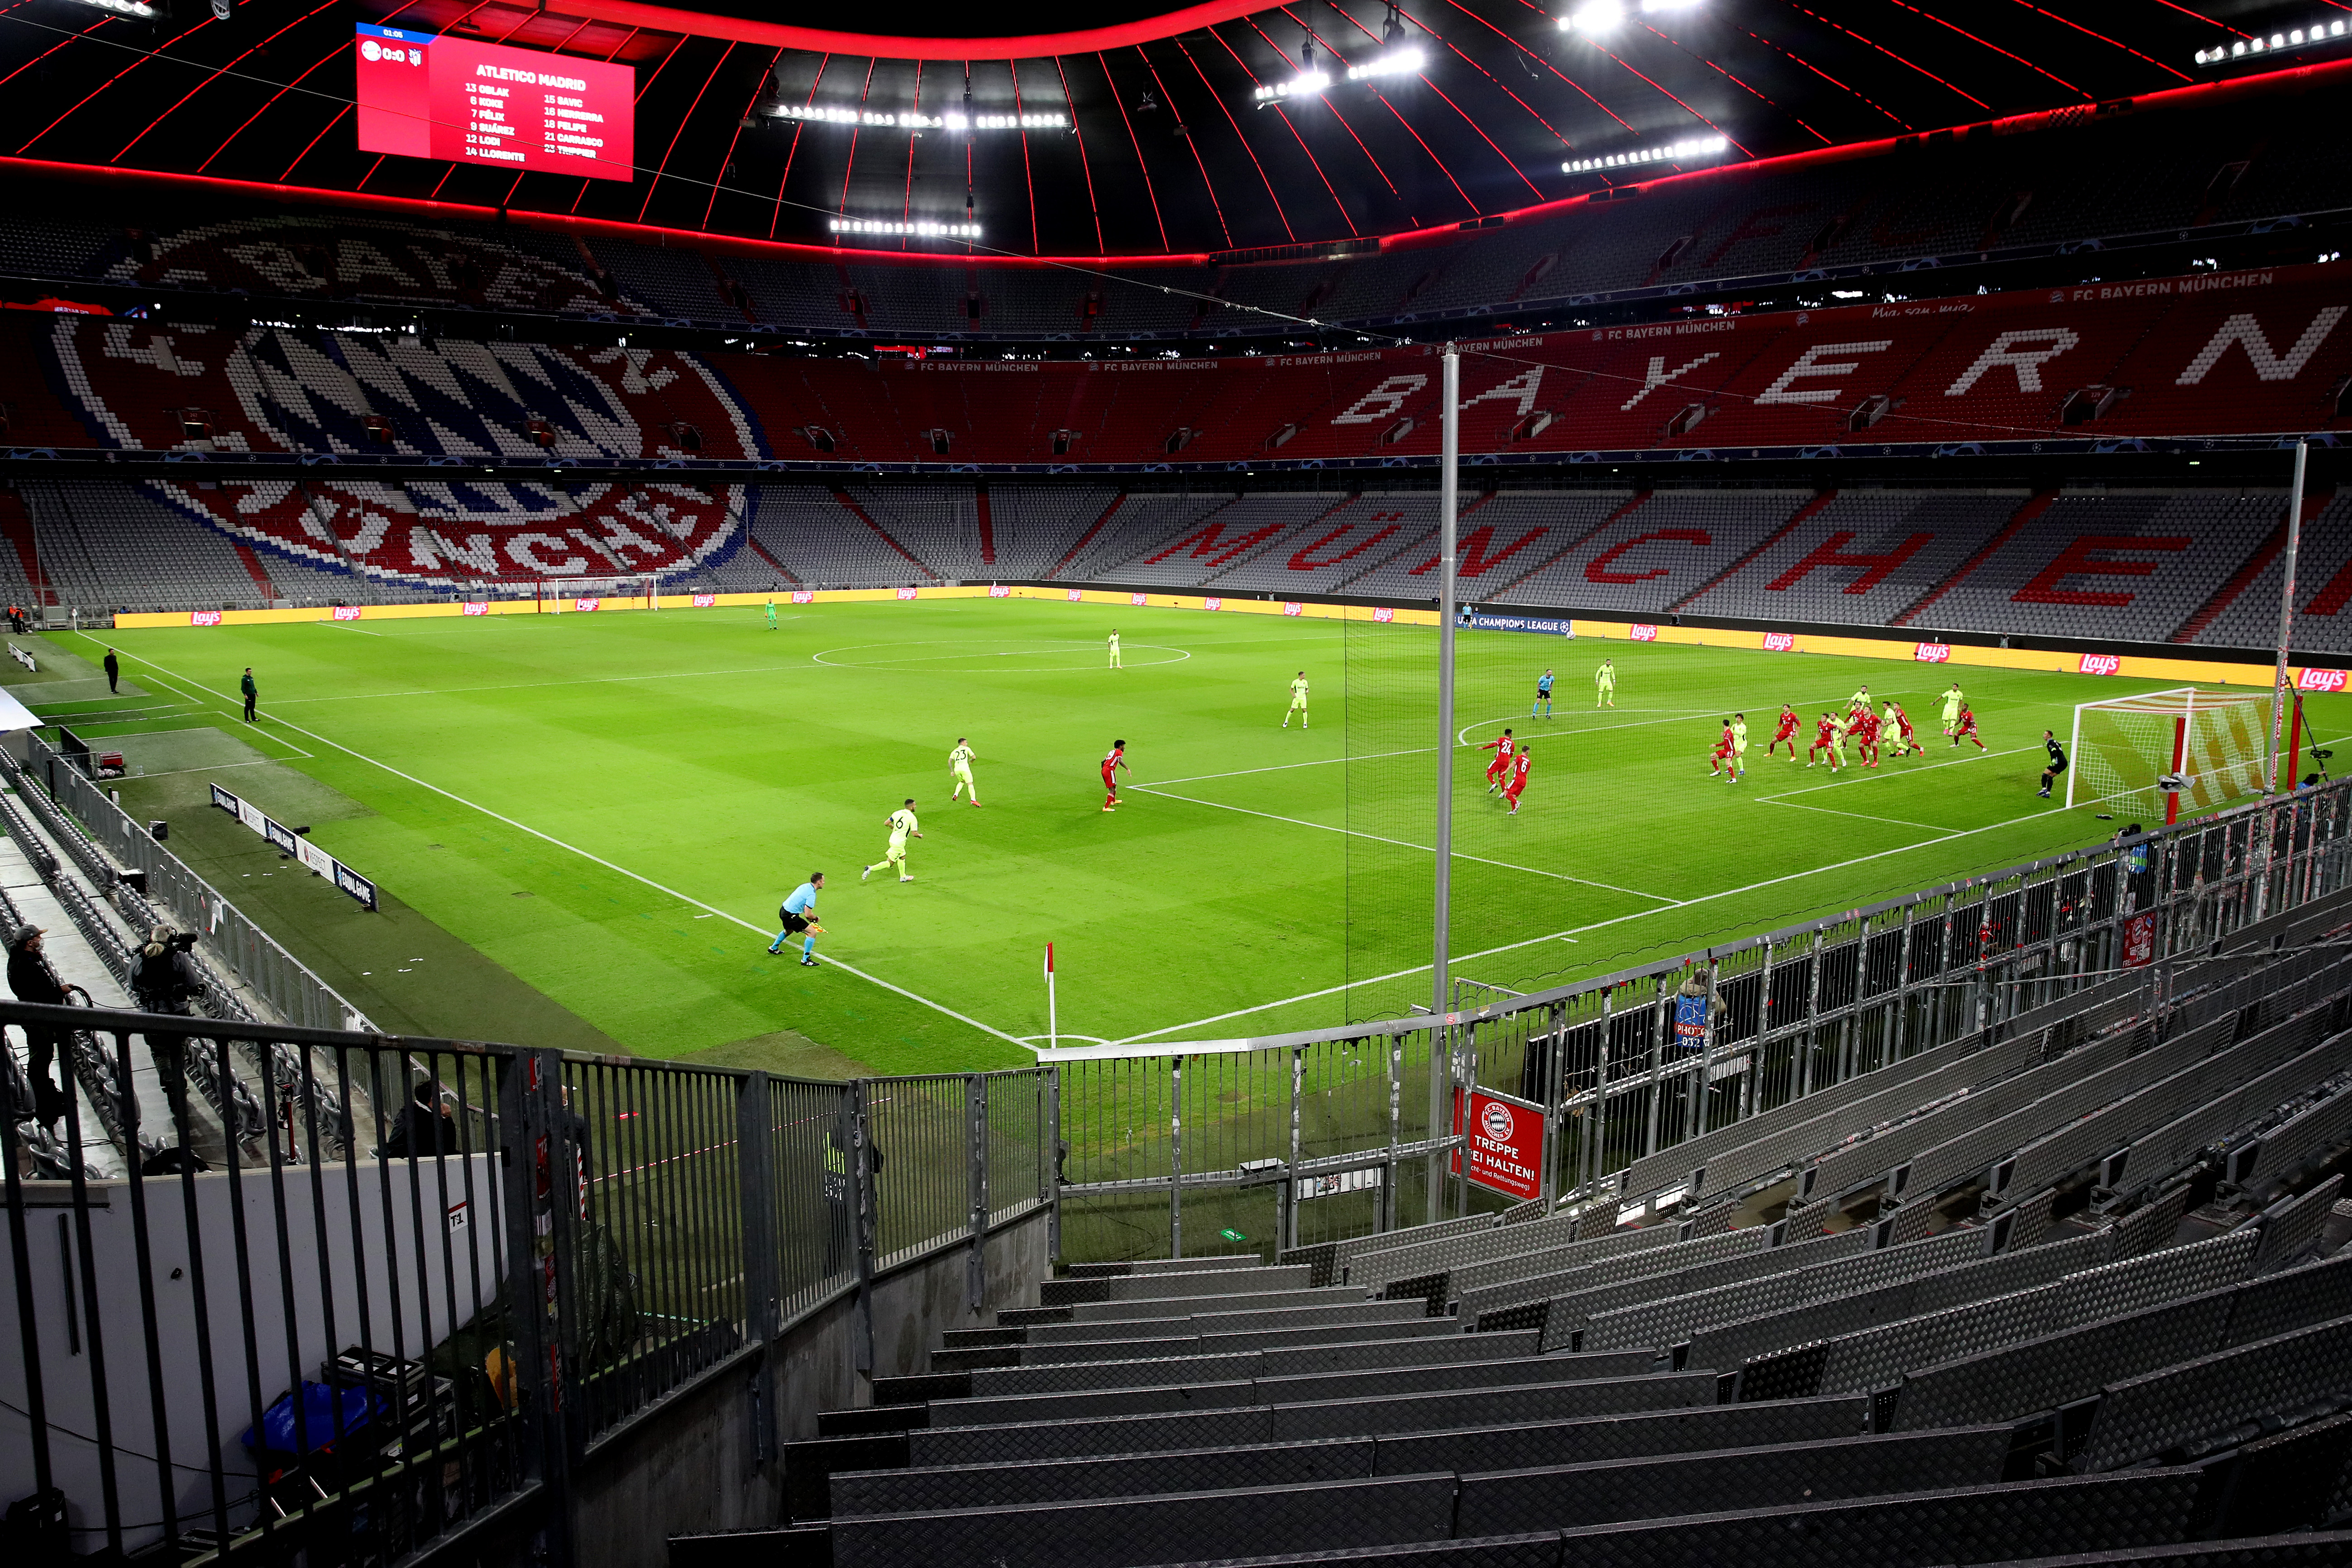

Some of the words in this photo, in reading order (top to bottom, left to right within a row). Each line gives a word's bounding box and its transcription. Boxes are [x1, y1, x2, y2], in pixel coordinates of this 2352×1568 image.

[383, 29, 403, 38] 01:05
[382, 48, 405, 62] 0:0
[477, 64, 536, 84] ATLETICO
[539, 74, 586, 91] MADRID
[465, 83, 477, 92] 13
[479, 85, 509, 97] OBLAK
[470, 96, 477, 105] 6
[479, 97, 503, 109] KOKE
[544, 95, 555, 104] 15
[557, 96, 583, 108] SAVIC
[471, 109, 477, 117] 7
[479, 109, 505, 121] FÉLIX
[544, 107, 555, 116] 16
[470, 122, 477, 130] 9
[479, 123, 515, 136] SUÁREZ
[544, 119, 555, 128] 18
[557, 121, 587, 133] FELIPE
[466, 134, 477, 143] 12
[479, 136, 500, 146] LODI
[545, 132, 555, 141] 21
[557, 133, 603, 147] CARRASCO
[465, 147, 478, 156] 14
[479, 148, 525, 162] LLORENTE
[544, 144, 555, 153] 23
[2073, 291, 2094, 301] FC
[2101, 283, 2171, 299] BAYERN
[2179, 276, 2273, 293] MÜNCHEN
[1608, 331, 1622, 339] FC
[1626, 326, 1671, 338] BAYERN
[1676, 322, 1735, 334] MÜNCHEN
[1493, 338, 1543, 350] MÜNCHEN
[1167, 361, 1218, 370] MÜNCHEN
[1296, 356, 1333, 365] BAYERN
[1337, 353, 1381, 362] MÜNCHEN
[1331, 306, 2348, 424] BAYERN
[921, 363, 934, 371] FC
[985, 362, 1038, 372] MÜNCHEN
[793, 592, 813, 603] Lay's
[898, 588, 917, 600] Lay's
[990, 586, 1009, 597] Lay's
[1068, 589, 1081, 601] Lay's
[576, 598, 598, 611] Lay's
[694, 595, 714, 607] Lay's
[1132, 593, 1146, 605] Lay's
[1205, 597, 1221, 610] Lay's
[335, 607, 360, 620] Lay's
[464, 602, 487, 616] Lay's
[1284, 602, 1301, 616] Lay's
[1374, 607, 1393, 622] Lay's
[193, 611, 220, 626] Lay's
[1458, 616, 1477, 625] UA
[1479, 618, 1525, 629] CHAMPIONS
[1527, 620, 1558, 631] LEAGUE
[1631, 624, 1656, 641] Lay's
[1764, 633, 1793, 651] Lay's
[1916, 643, 1949, 662] Lay's
[2080, 654, 2118, 675] Lay's
[2299, 668, 2345, 691] Lay's
[955, 750, 966, 761] 23
[1501, 742, 1512, 755] 24
[1521, 761, 1528, 772] 6
[896, 817, 904, 829] 6
[1492, 1106, 1511, 1122] BAYERN
[1475, 1135, 1519, 1159] TREPPE
[1487, 1155, 1535, 1181] HALTEN!
[1482, 1168, 1492, 1177] und
[1493, 1172, 1530, 1191] Rettungsweg)
[450, 1212, 464, 1227] T1
